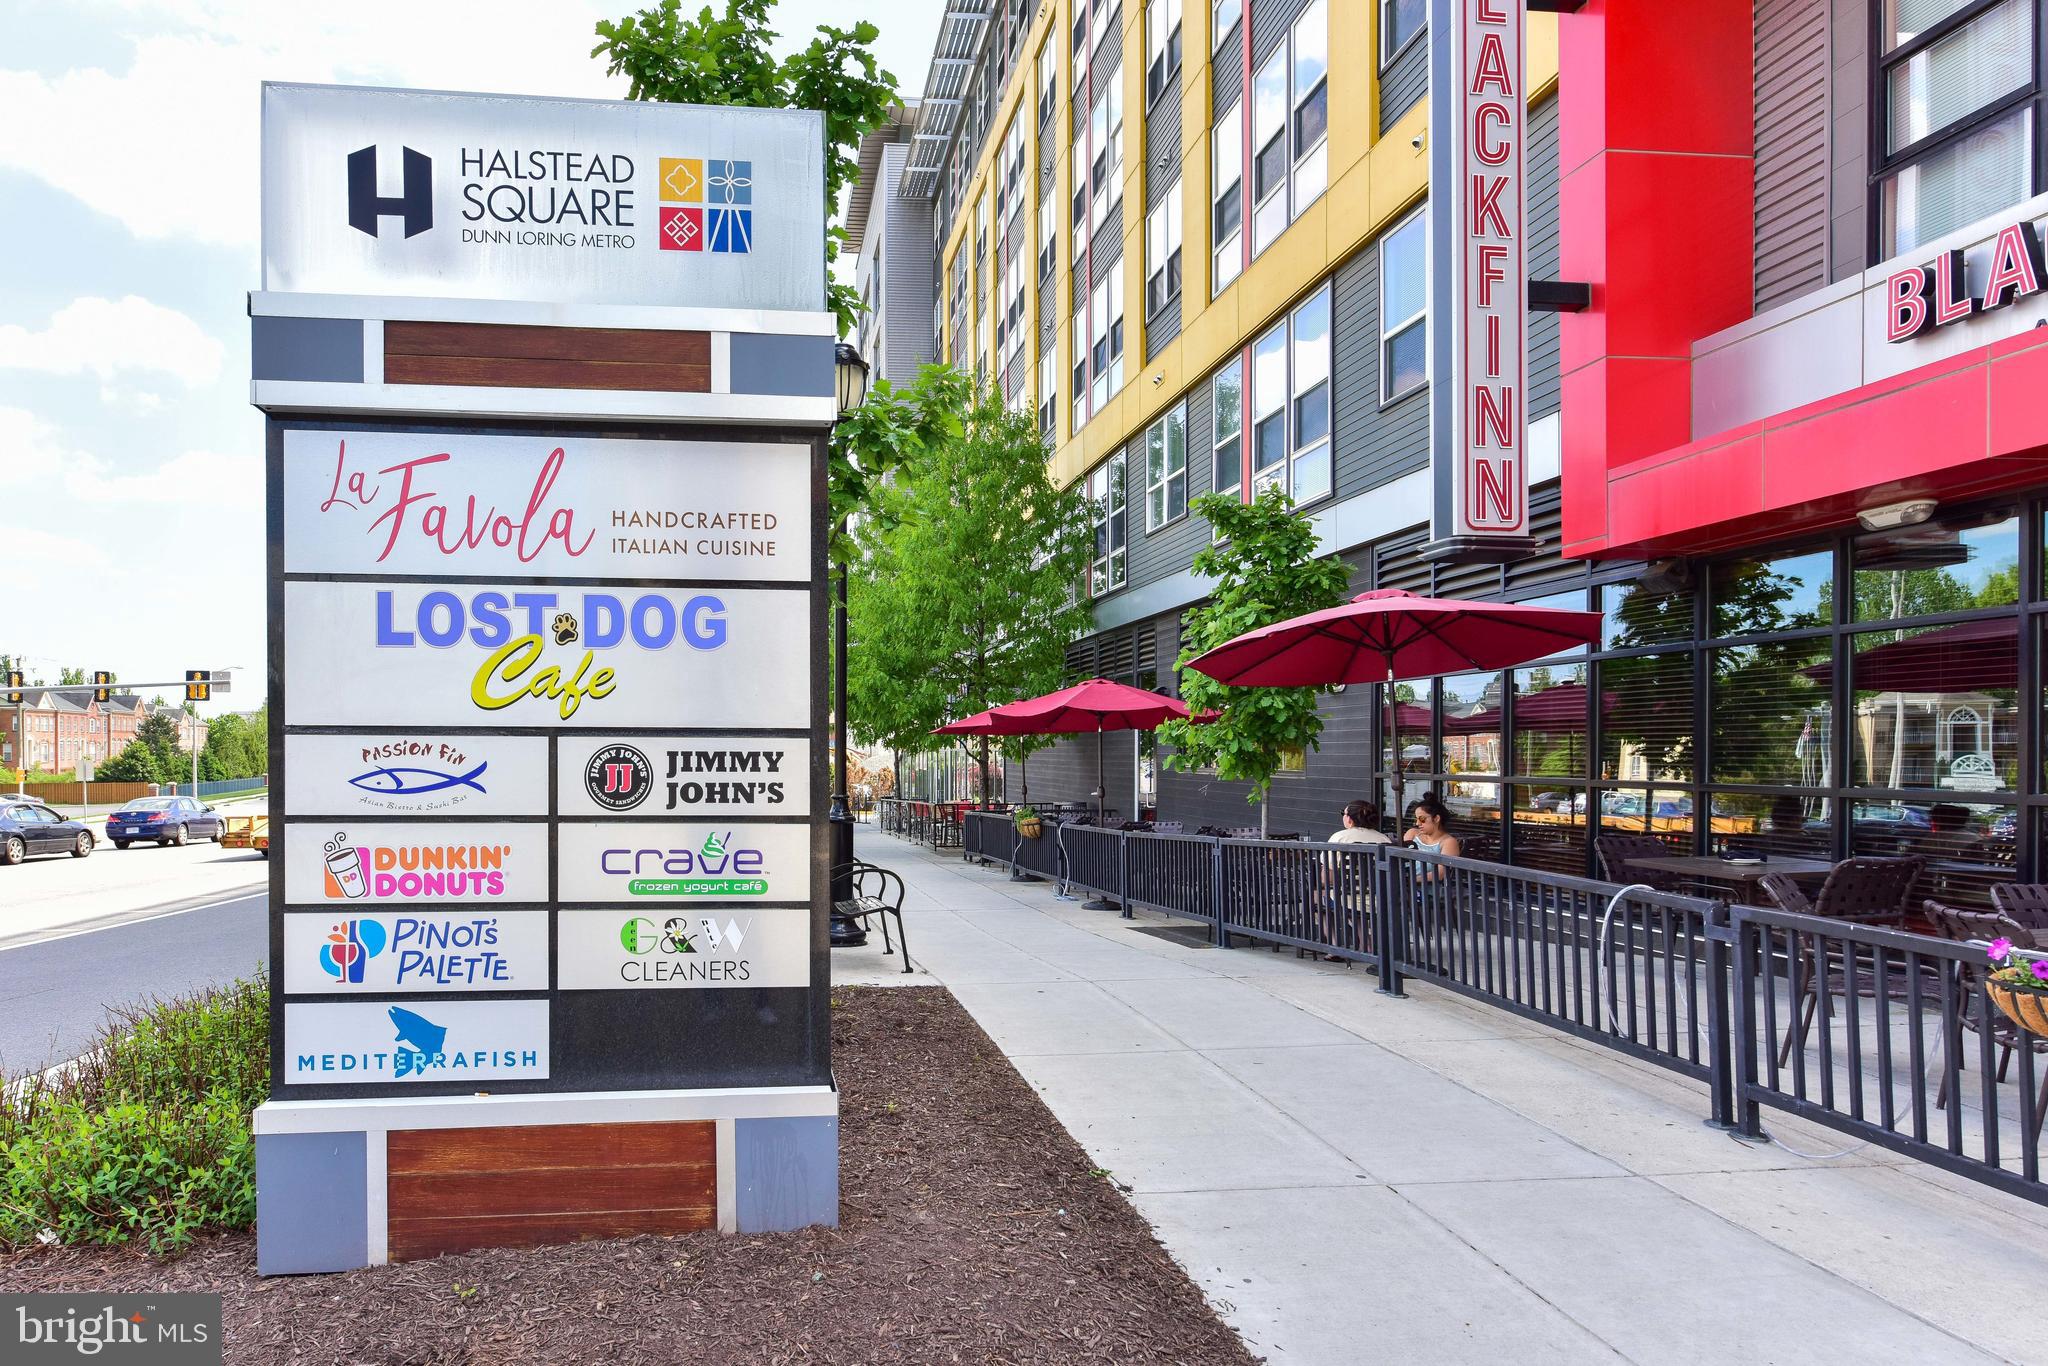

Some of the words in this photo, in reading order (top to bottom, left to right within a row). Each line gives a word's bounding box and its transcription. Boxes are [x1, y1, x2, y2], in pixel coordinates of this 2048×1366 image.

[461, 147, 635, 184] HALSTEAD
[461, 183, 635, 227] SQUARE
[462, 228, 511, 245] DUNN
[516, 230, 576, 248] LORING
[581, 232, 635, 249] METRO
[1886, 222, 2048, 343] BLA
[321, 439, 379, 512] La
[367, 447, 595, 563] Favola
[611, 509, 778, 531] HANDCRAFTED
[611, 537, 688, 555] ITALIAN
[696, 539, 777, 557] CUISINE
[375, 589, 559, 649] LOST
[582, 592, 729, 650] DOG
[470, 633, 617, 720] Cafe
[591, 750, 617, 778] JIMMY
[605, 763, 634, 793] JJ
[666, 751, 785, 779] JIMMY
[359, 796, 384, 807] Asian
[386, 801, 414, 811] Bistro
[426, 801, 450, 811] Sushi
[451, 795, 468, 805] Bar
[666, 782, 785, 810] JOHN'S
[374, 845, 512, 871] DUNKIN'
[602, 849, 763, 875] crave
[374, 871, 505, 897] DONUTS
[634, 881, 679, 891] frozen
[683, 882, 729, 894] yogurt
[733, 881, 763, 891] café
[397, 950, 510, 985] PALETTE
[620, 960, 751, 982] CLEANERS
[298, 1051, 537, 1071] MEDITERRAFISH
